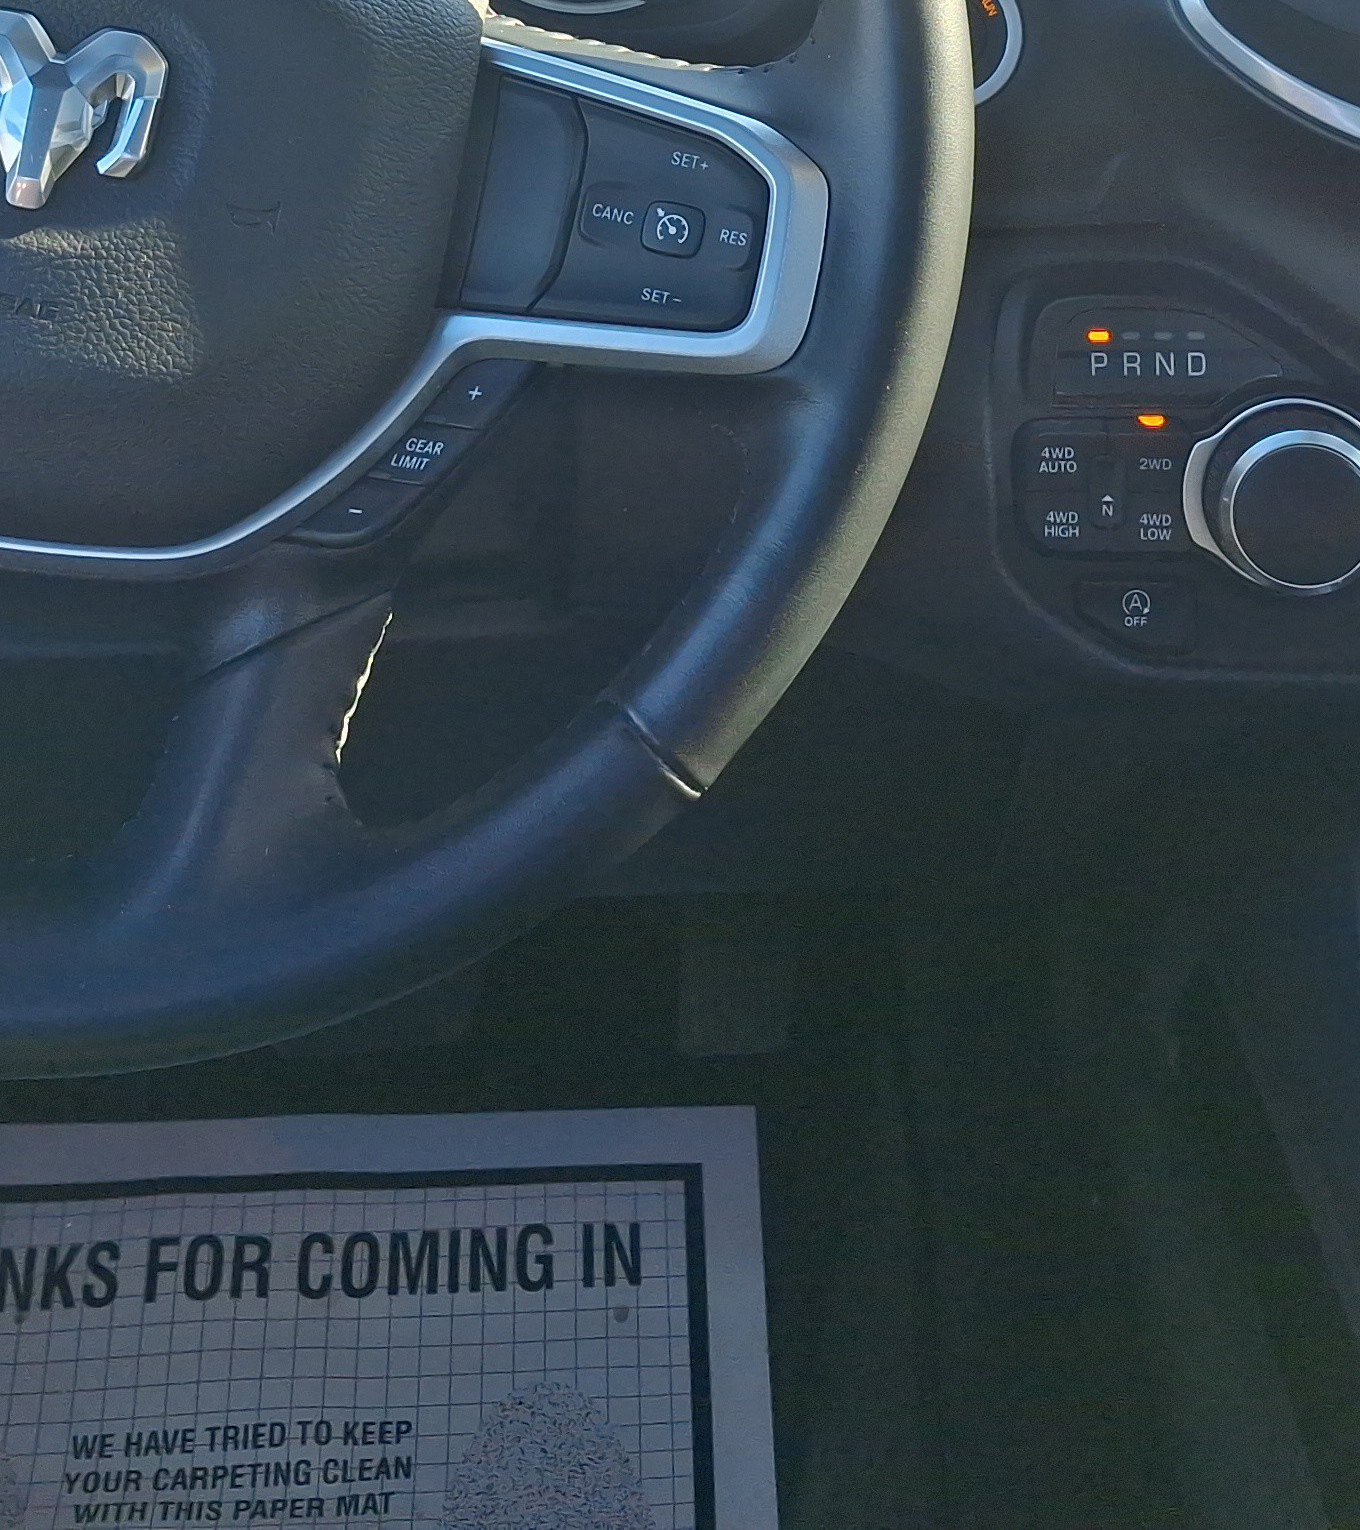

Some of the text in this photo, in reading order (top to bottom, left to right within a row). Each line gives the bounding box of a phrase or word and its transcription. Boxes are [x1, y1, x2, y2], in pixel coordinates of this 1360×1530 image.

[591, 202, 635, 226] CANC
[719, 227, 748, 248] RES
[1090, 351, 1208, 377] P R N D
[405, 437, 445, 457] GEAR
[1040, 445, 1076, 461] 4WD
[390, 453, 431, 472] LIMIT
[1039, 460, 1078, 474] AUTO
[1139, 457, 1173, 471] 2WD
[1045, 510, 1079, 525] 4WD
[1101, 503, 1115, 517] N
[1139, 513, 1173, 528] 4WD
[1044, 523, 1081, 539] HIGH
[1140, 526, 1173, 541] LOW
[1123, 615, 1148, 628] OFF
[143, 1231, 273, 1305] FOR
[296, 1221, 555, 1302] COMING
[580, 1221, 643, 1290] IN
[71, 1417, 415, 1462] WE HAVE TRIED TO KEEP
[64, 1454, 415, 1497] YOUR CARPETING CLEAN
[73, 1490, 397, 1525] WITH THIS PAPER MAT
